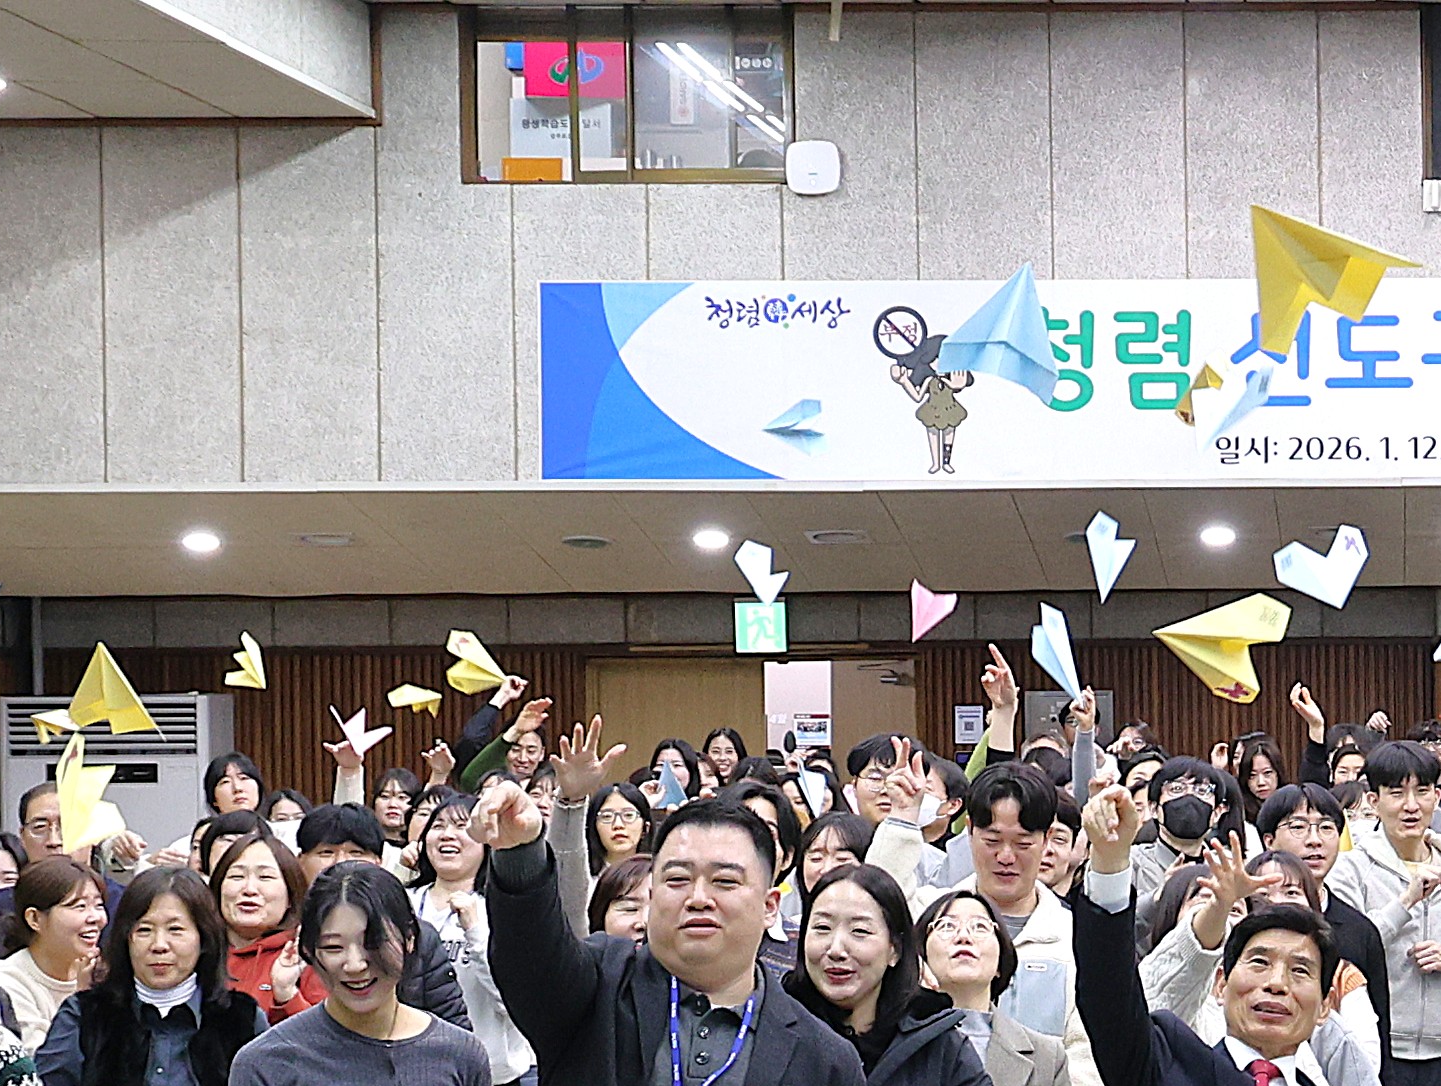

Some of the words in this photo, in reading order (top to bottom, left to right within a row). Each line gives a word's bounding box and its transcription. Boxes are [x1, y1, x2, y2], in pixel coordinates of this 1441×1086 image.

[1042, 306, 1191, 411] 청렴
[1215, 436, 1279, 465] 일시:
[1289, 437, 1370, 463] 2026.
[1380, 436, 1405, 463] 1.
